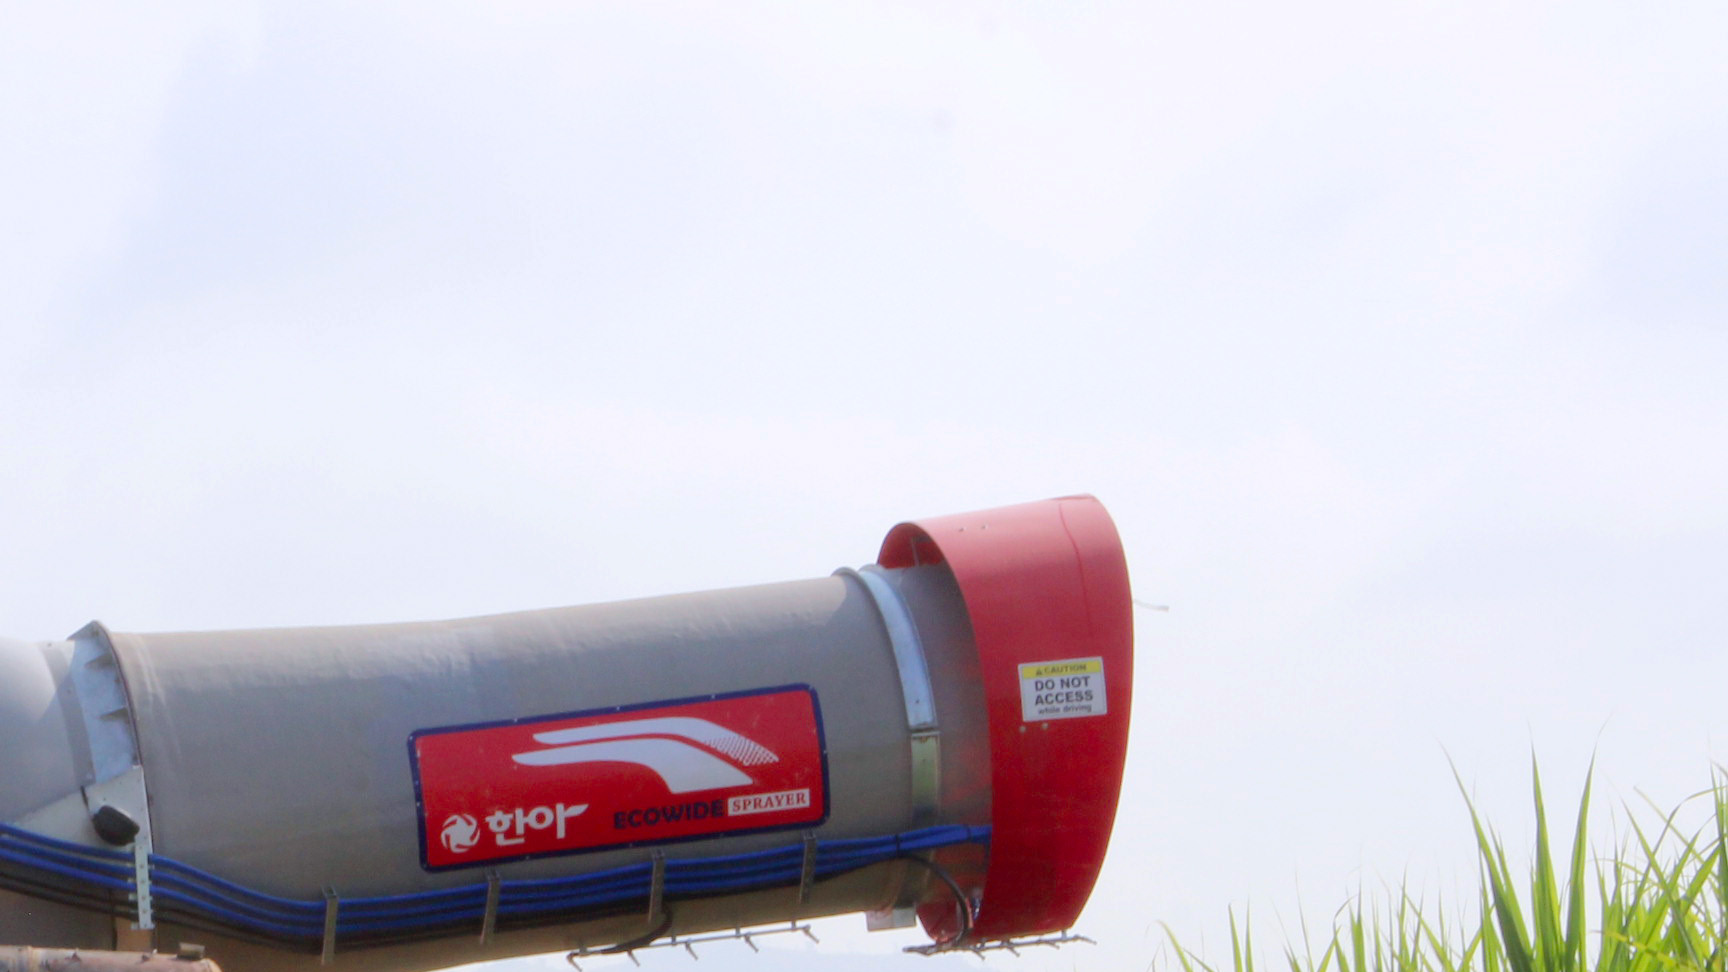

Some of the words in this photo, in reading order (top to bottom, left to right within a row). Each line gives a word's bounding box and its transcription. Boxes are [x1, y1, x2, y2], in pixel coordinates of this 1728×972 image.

[1044, 664, 1087, 673] CAUTION
[1035, 679, 1055, 692] DO
[1060, 675, 1090, 689] NOT
[1035, 690, 1094, 706] ACCESS
[1038, 706, 1060, 715] while
[1063, 704, 1092, 713] driving
[613, 800, 723, 831] ECOWIDE
[731, 792, 808, 813] SPRAYER
[484, 803, 589, 847] 한아
